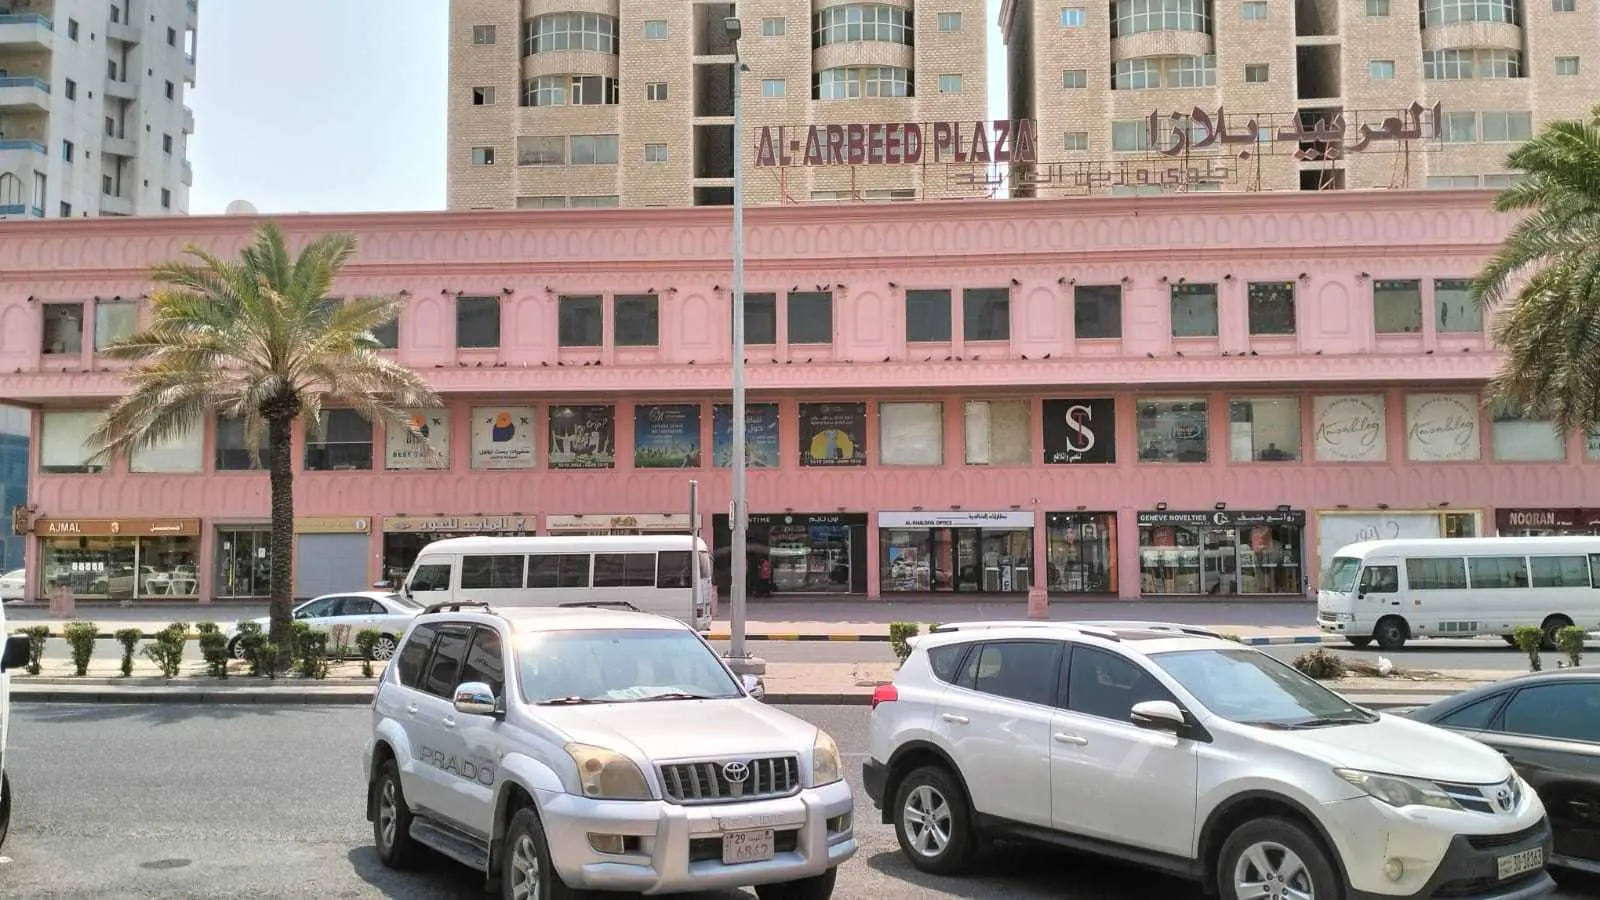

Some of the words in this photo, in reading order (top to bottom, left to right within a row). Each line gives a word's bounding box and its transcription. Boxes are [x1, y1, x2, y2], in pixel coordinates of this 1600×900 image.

[755, 122, 922, 167] AL-ARBEED
[933, 119, 1038, 163] PLAZA
[1149, 104, 1259, 161] بلازا
[1276, 99, 1442, 160] العربيد
[49, 522, 81, 533] AJMAL
[1509, 511, 1555, 526] NOORAN
[420, 745, 495, 786] PRADO
